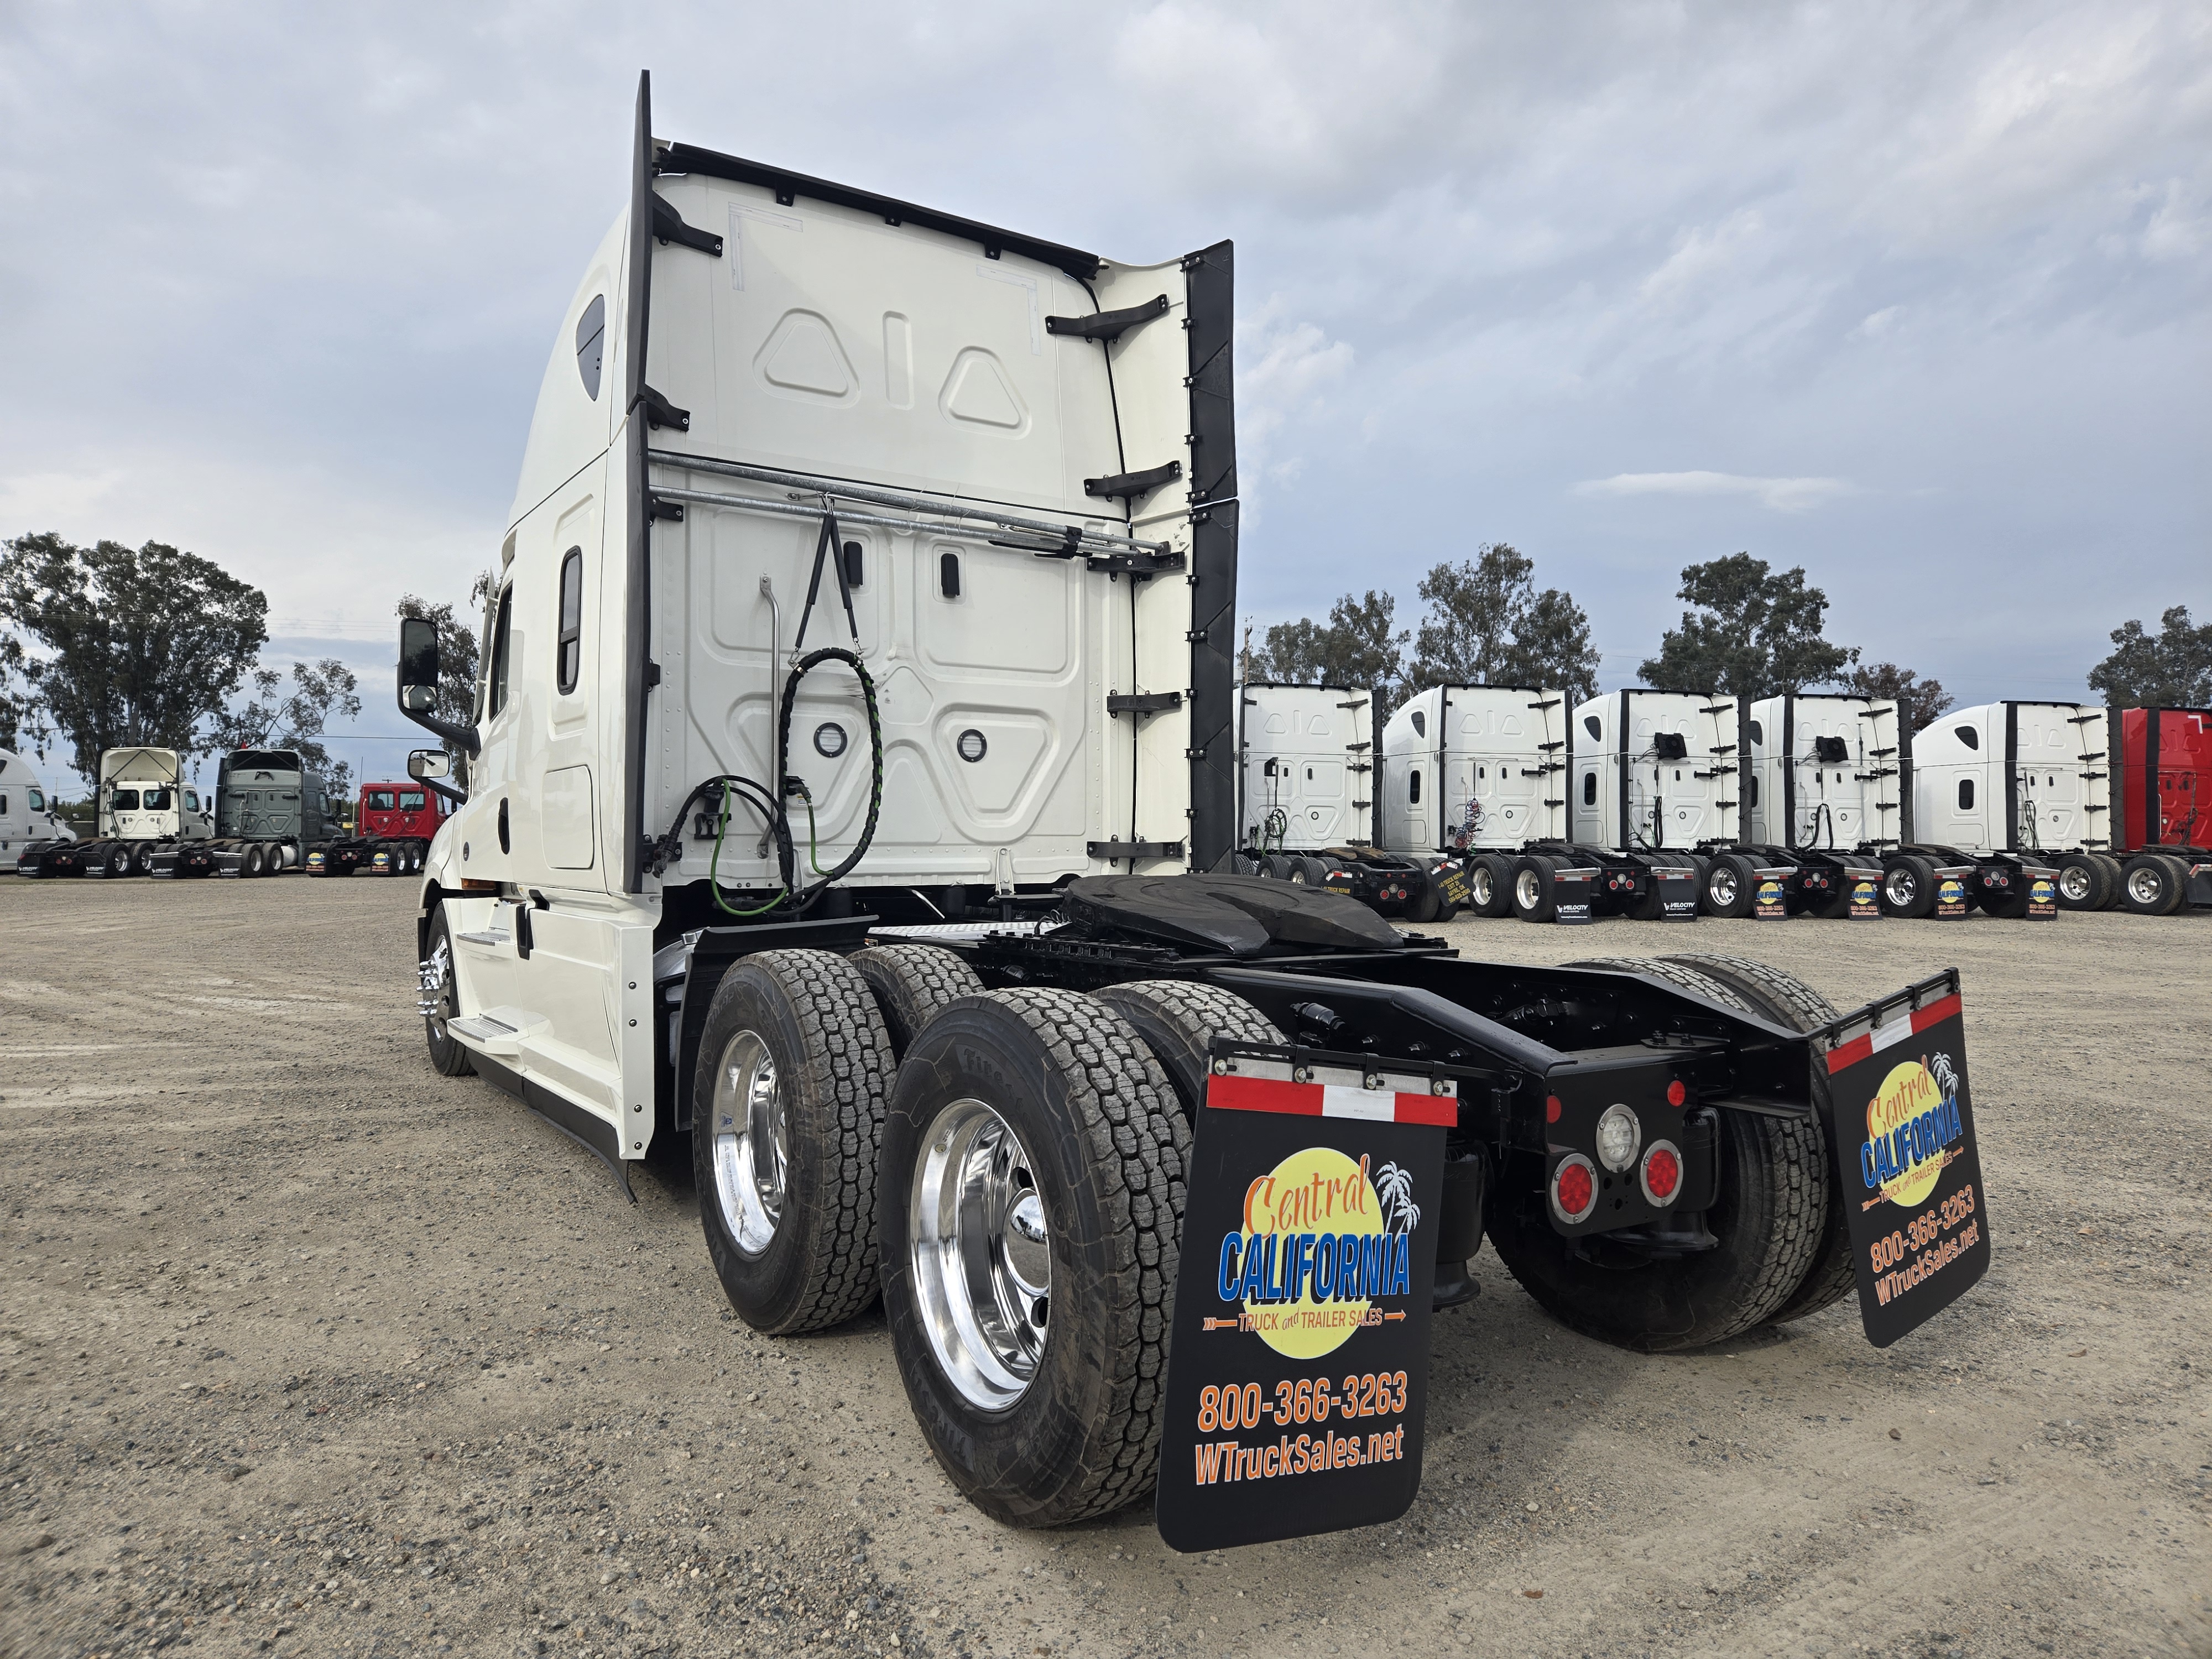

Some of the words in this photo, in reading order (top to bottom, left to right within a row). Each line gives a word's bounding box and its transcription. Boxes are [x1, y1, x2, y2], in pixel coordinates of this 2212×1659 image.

[1443, 876, 1454, 885] TRUCK
[1453, 870, 1465, 880] REPAIR
[1866, 1055, 1932, 1139] Central
[1861, 1095, 1963, 1188] CALIFORNIA
[1244, 1154, 1370, 1239] Central
[1879, 1182, 1901, 1204] TRUCK
[1902, 1173, 1911, 1191] and
[1911, 1163, 1935, 1185] TRAILER
[1936, 1151, 1953, 1170] SALES
[1871, 1184, 1975, 1273] 800-366-3263
[1875, 1218, 1979, 1306] WTruckSales.net
[1218, 1232, 1410, 1302] CALIFORNIA
[1239, 1313, 1279, 1332] TRUCK
[1282, 1307, 1300, 1331] and
[1301, 1311, 1346, 1328] TRAILER
[1349, 1307, 1383, 1327] SALES
[1198, 1370, 1407, 1432] 800-366-3263
[1196, 1423, 1404, 1485] WTruckSales.net
